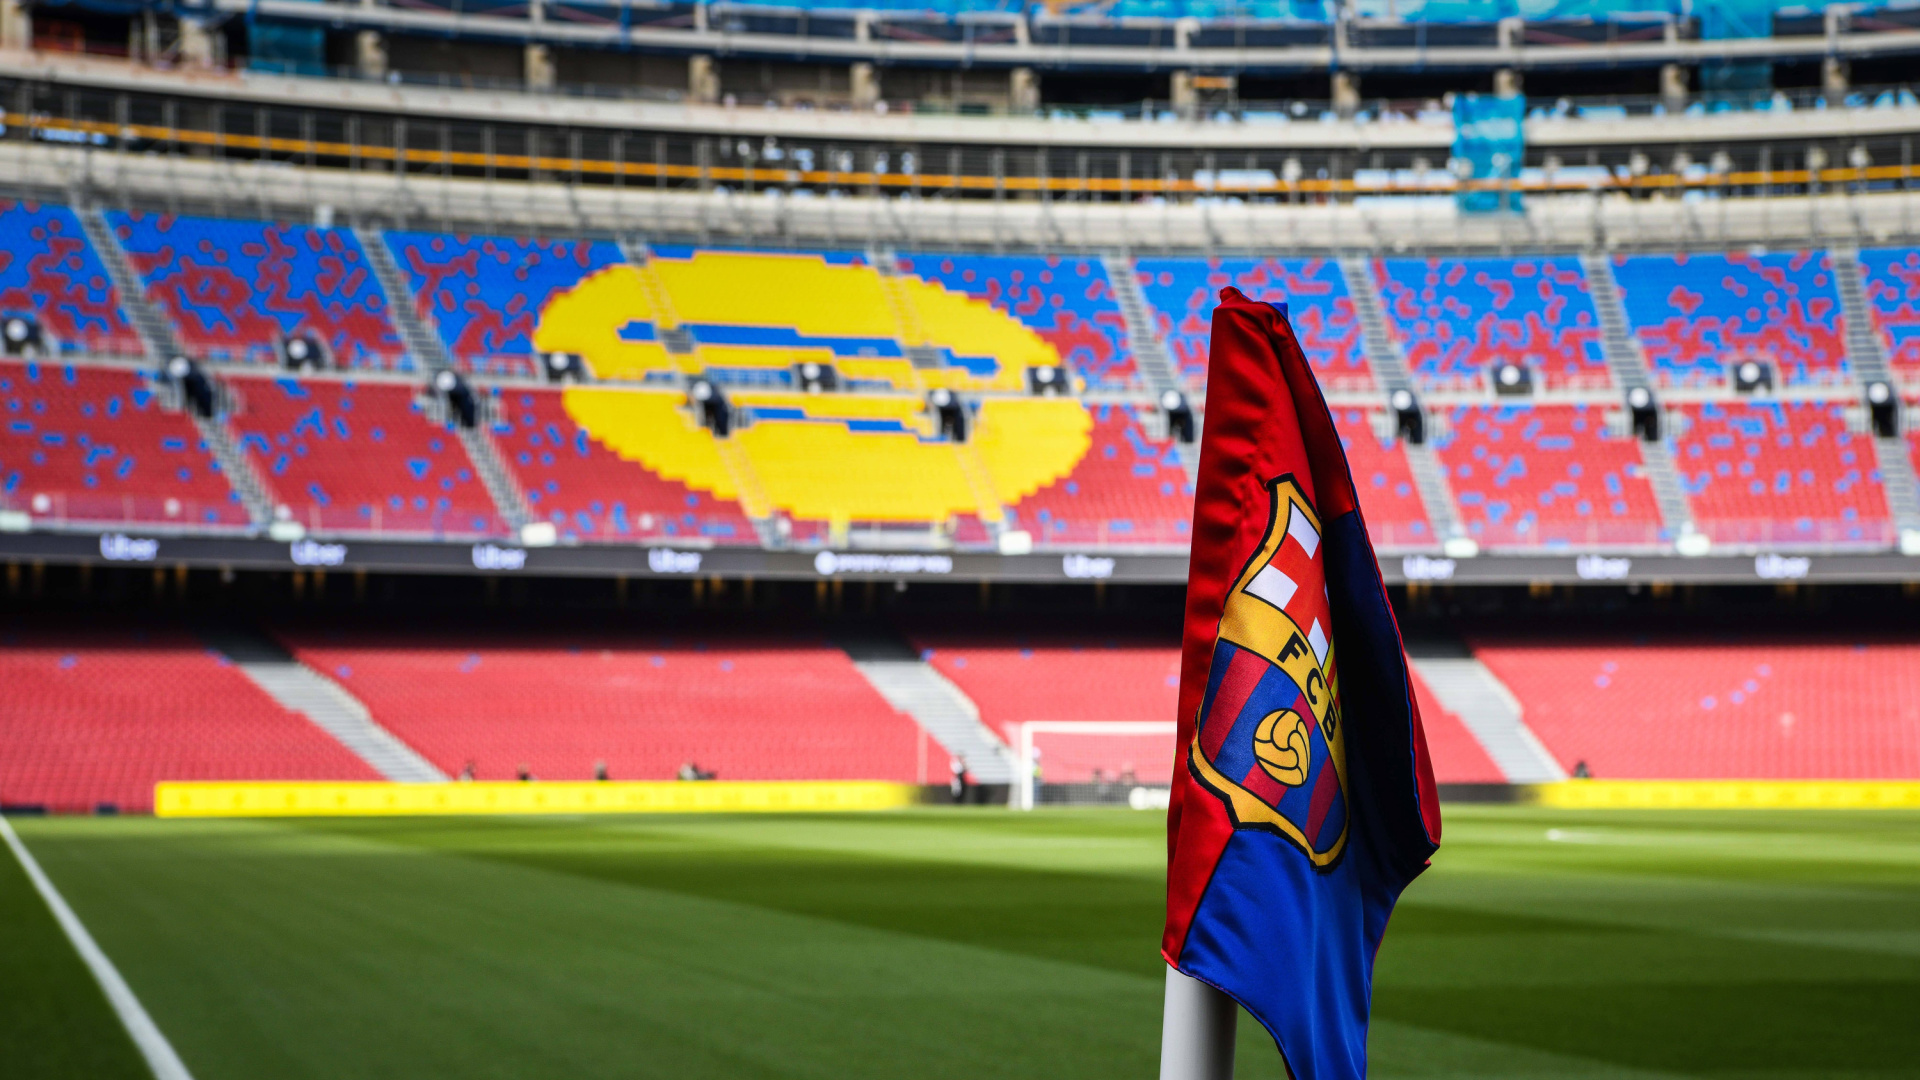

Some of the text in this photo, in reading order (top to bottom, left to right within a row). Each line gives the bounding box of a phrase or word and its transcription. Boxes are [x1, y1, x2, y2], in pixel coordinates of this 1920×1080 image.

[100, 533, 158, 560] Uber
[290, 538, 347, 565] Uber
[472, 543, 527, 569] Uber
[648, 547, 702, 573] Uber
[1063, 553, 1115, 578] Uber
[1403, 554, 1456, 579] Uber
[1576, 555, 1630, 579] Uber
[1755, 553, 1810, 578] Uber
[1277, 631, 1336, 742] FCB
